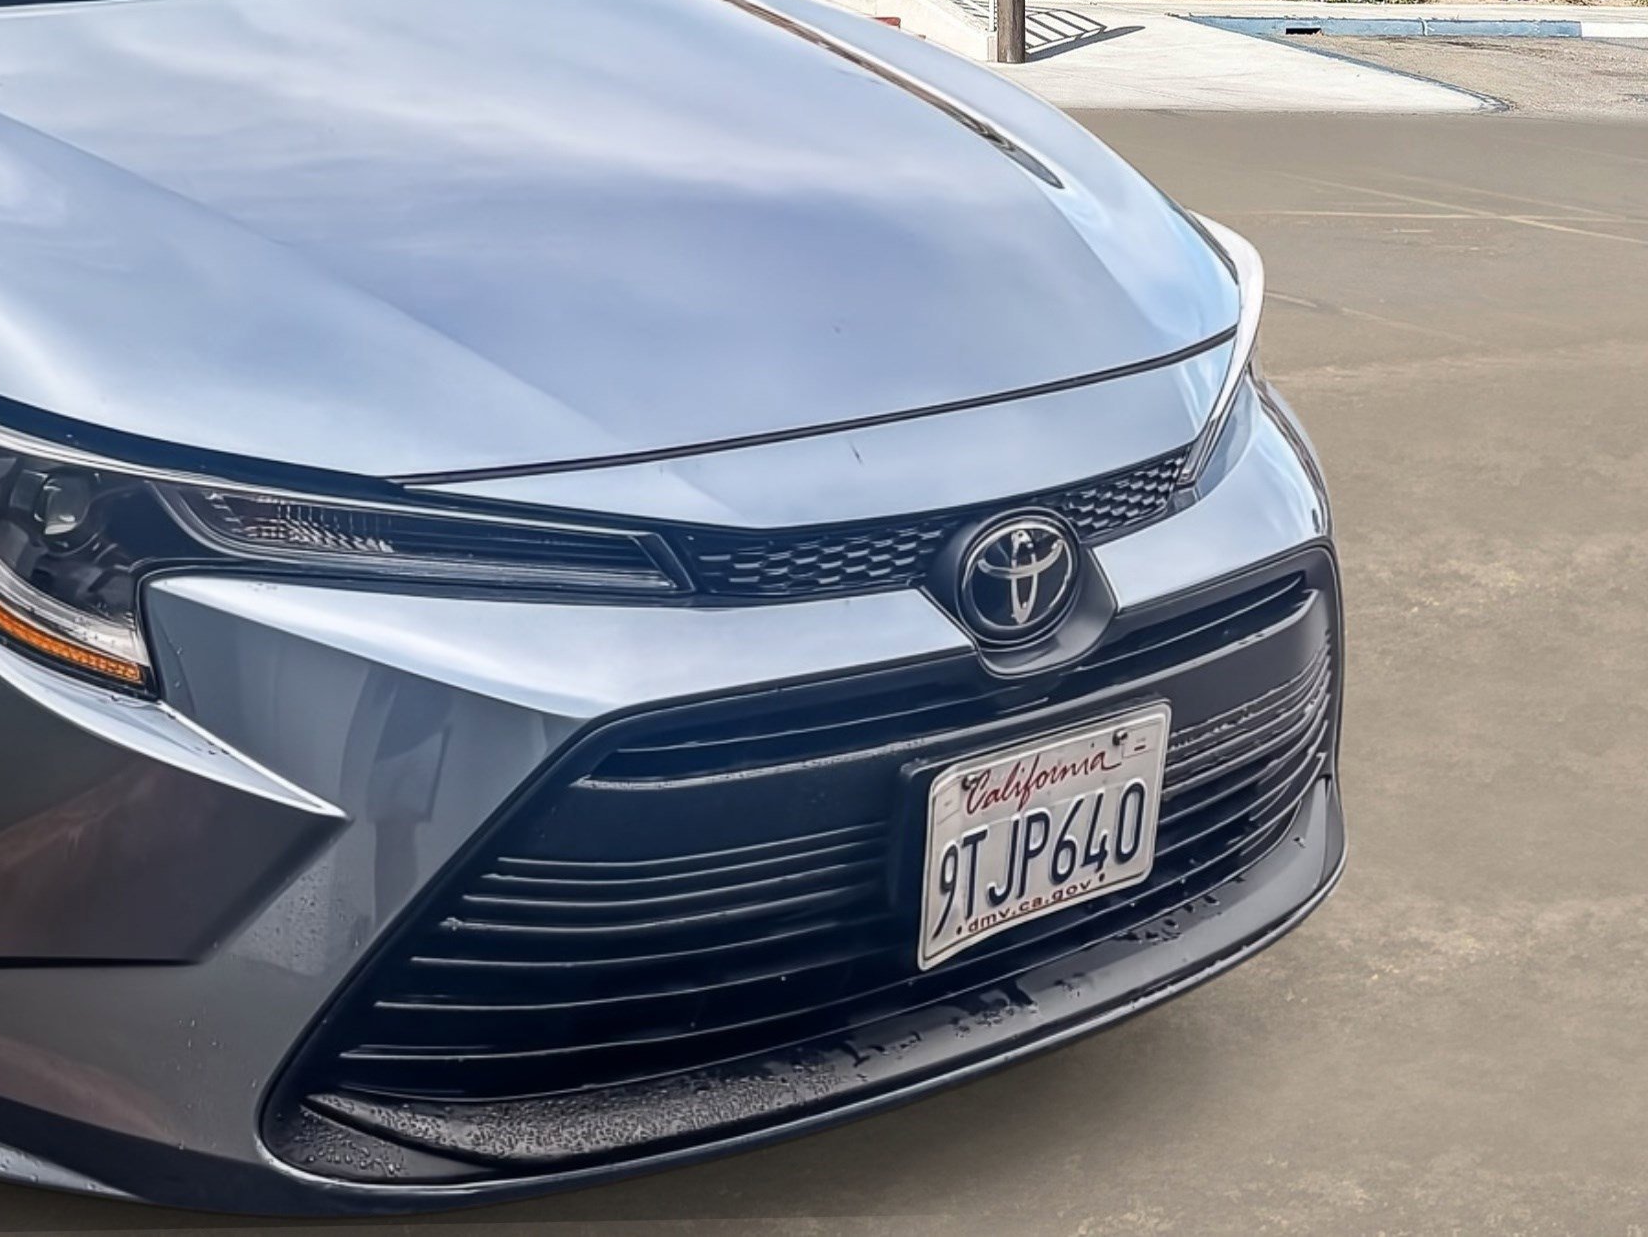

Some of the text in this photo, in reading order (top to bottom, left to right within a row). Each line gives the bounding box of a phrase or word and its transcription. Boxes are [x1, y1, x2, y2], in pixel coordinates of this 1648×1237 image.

[963, 750, 1121, 815] California
[932, 780, 1145, 940] 9TJP640
[968, 879, 1092, 933] dmv.ca.gov
